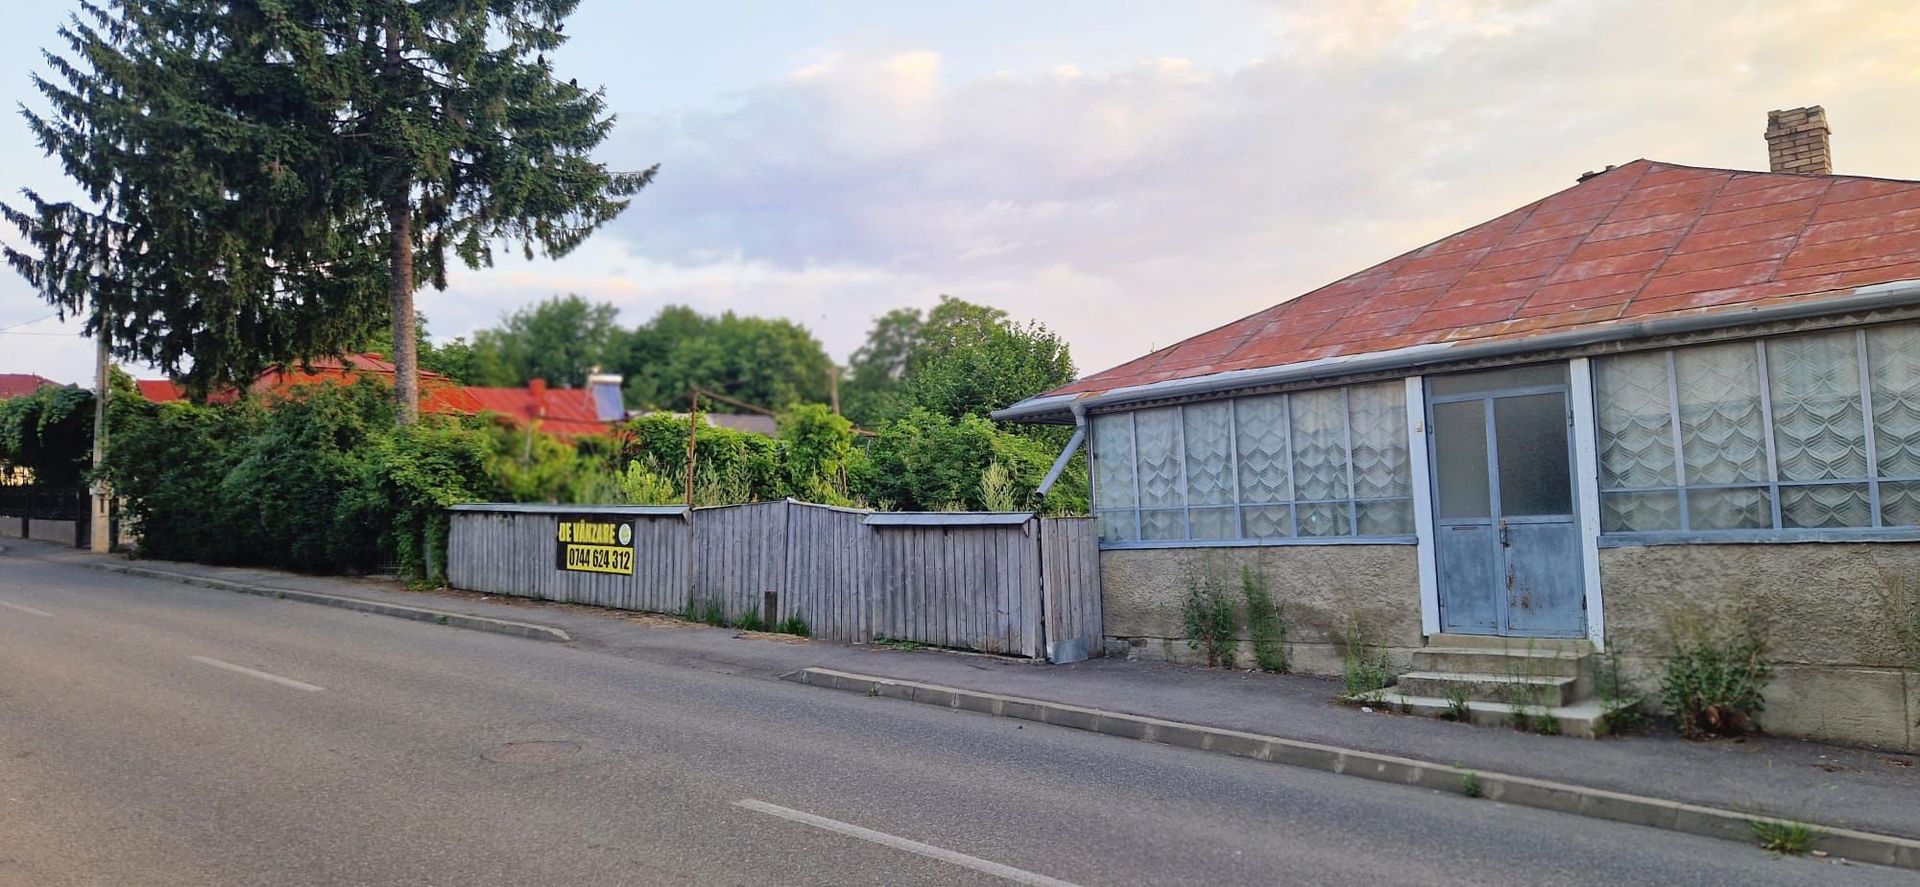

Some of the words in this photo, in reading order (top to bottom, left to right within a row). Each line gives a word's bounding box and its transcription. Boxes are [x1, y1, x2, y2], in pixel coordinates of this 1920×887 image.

[559, 522, 572, 542] DE
[569, 548, 590, 566] 0744
[592, 549, 609, 568] 624
[612, 550, 630, 570] 312
